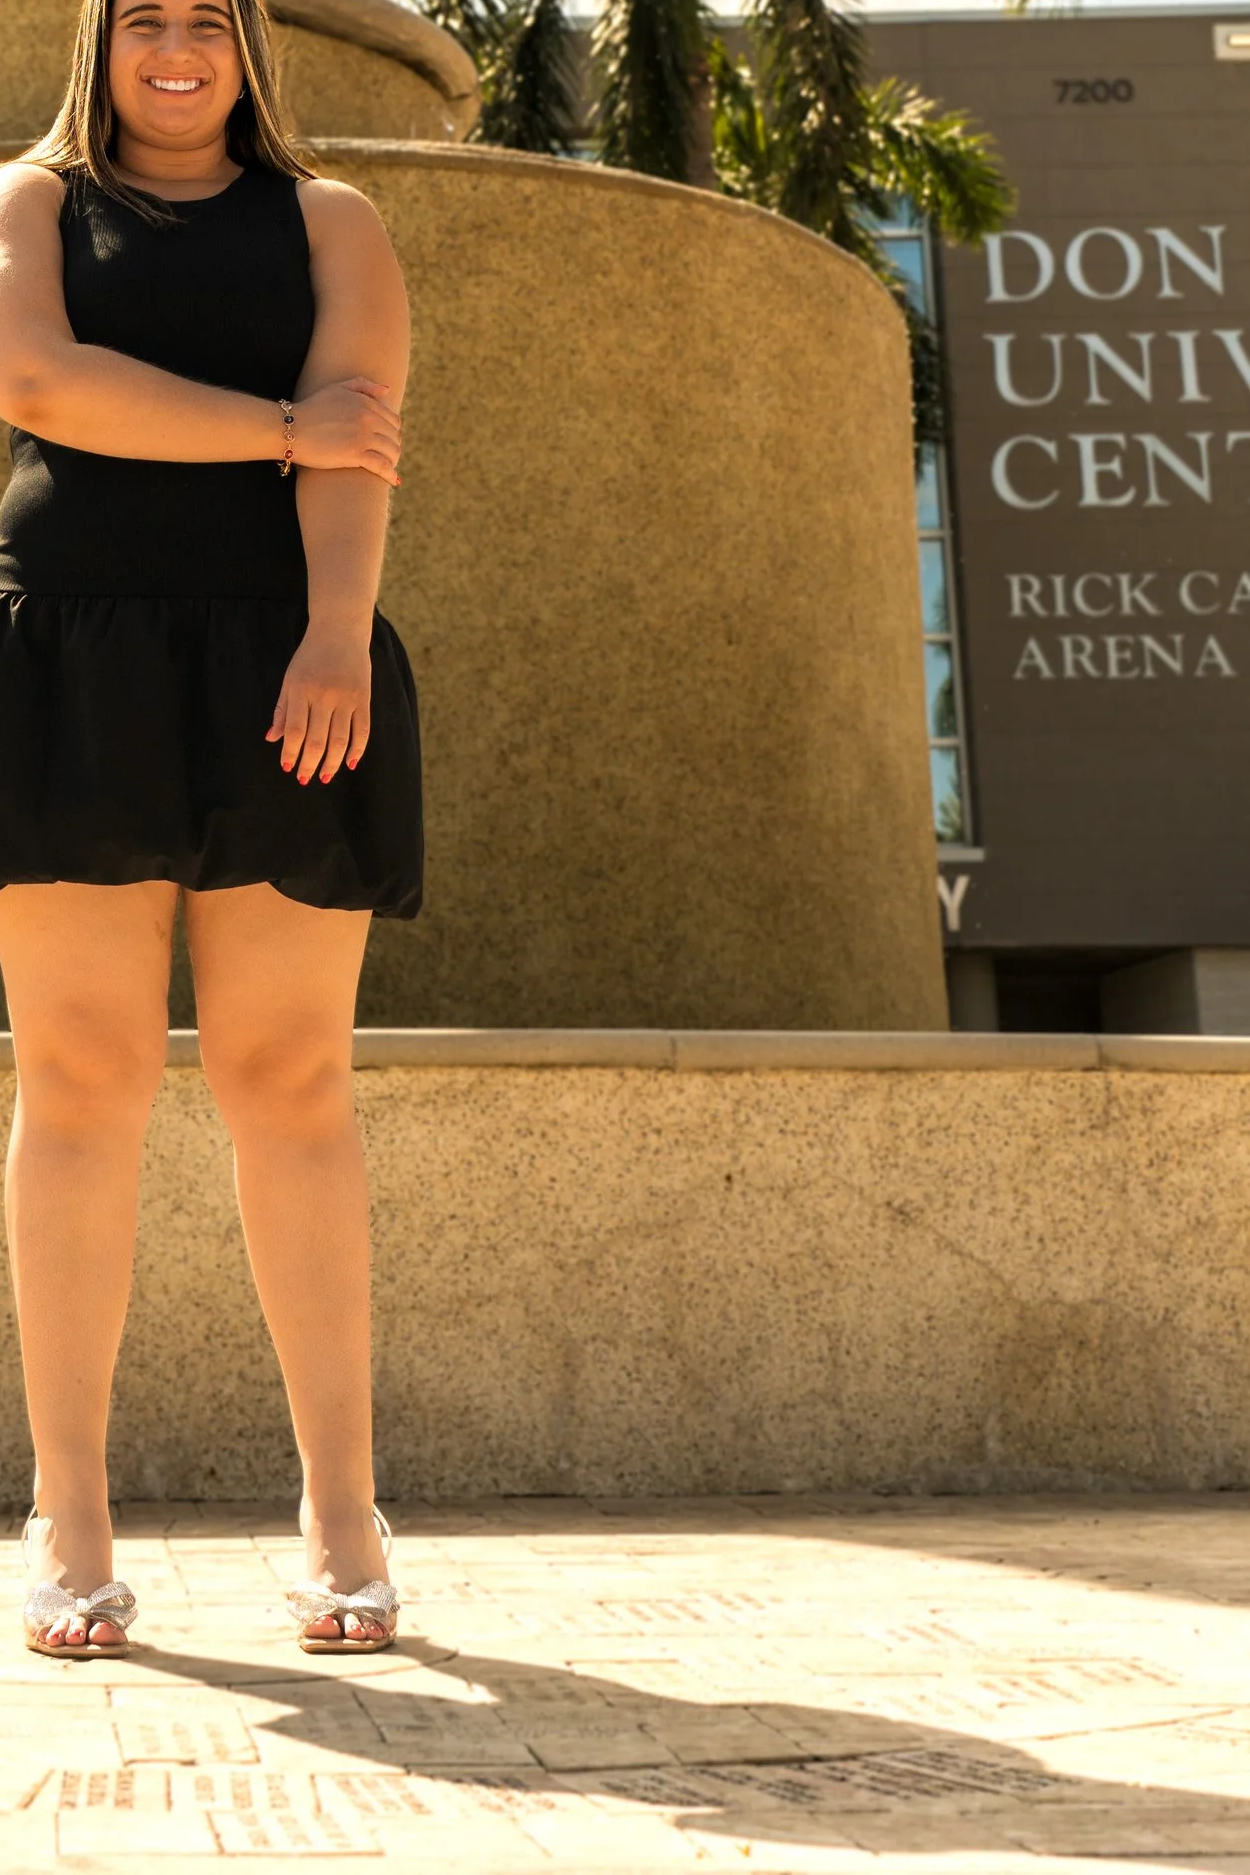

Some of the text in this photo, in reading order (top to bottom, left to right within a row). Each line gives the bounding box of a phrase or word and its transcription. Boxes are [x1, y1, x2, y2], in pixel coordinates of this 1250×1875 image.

[1053, 78, 1135, 105] 7200
[982, 225, 1226, 303] DON
[1005, 571, 1164, 617] RICK
[1012, 633, 1238, 680] ARENA
